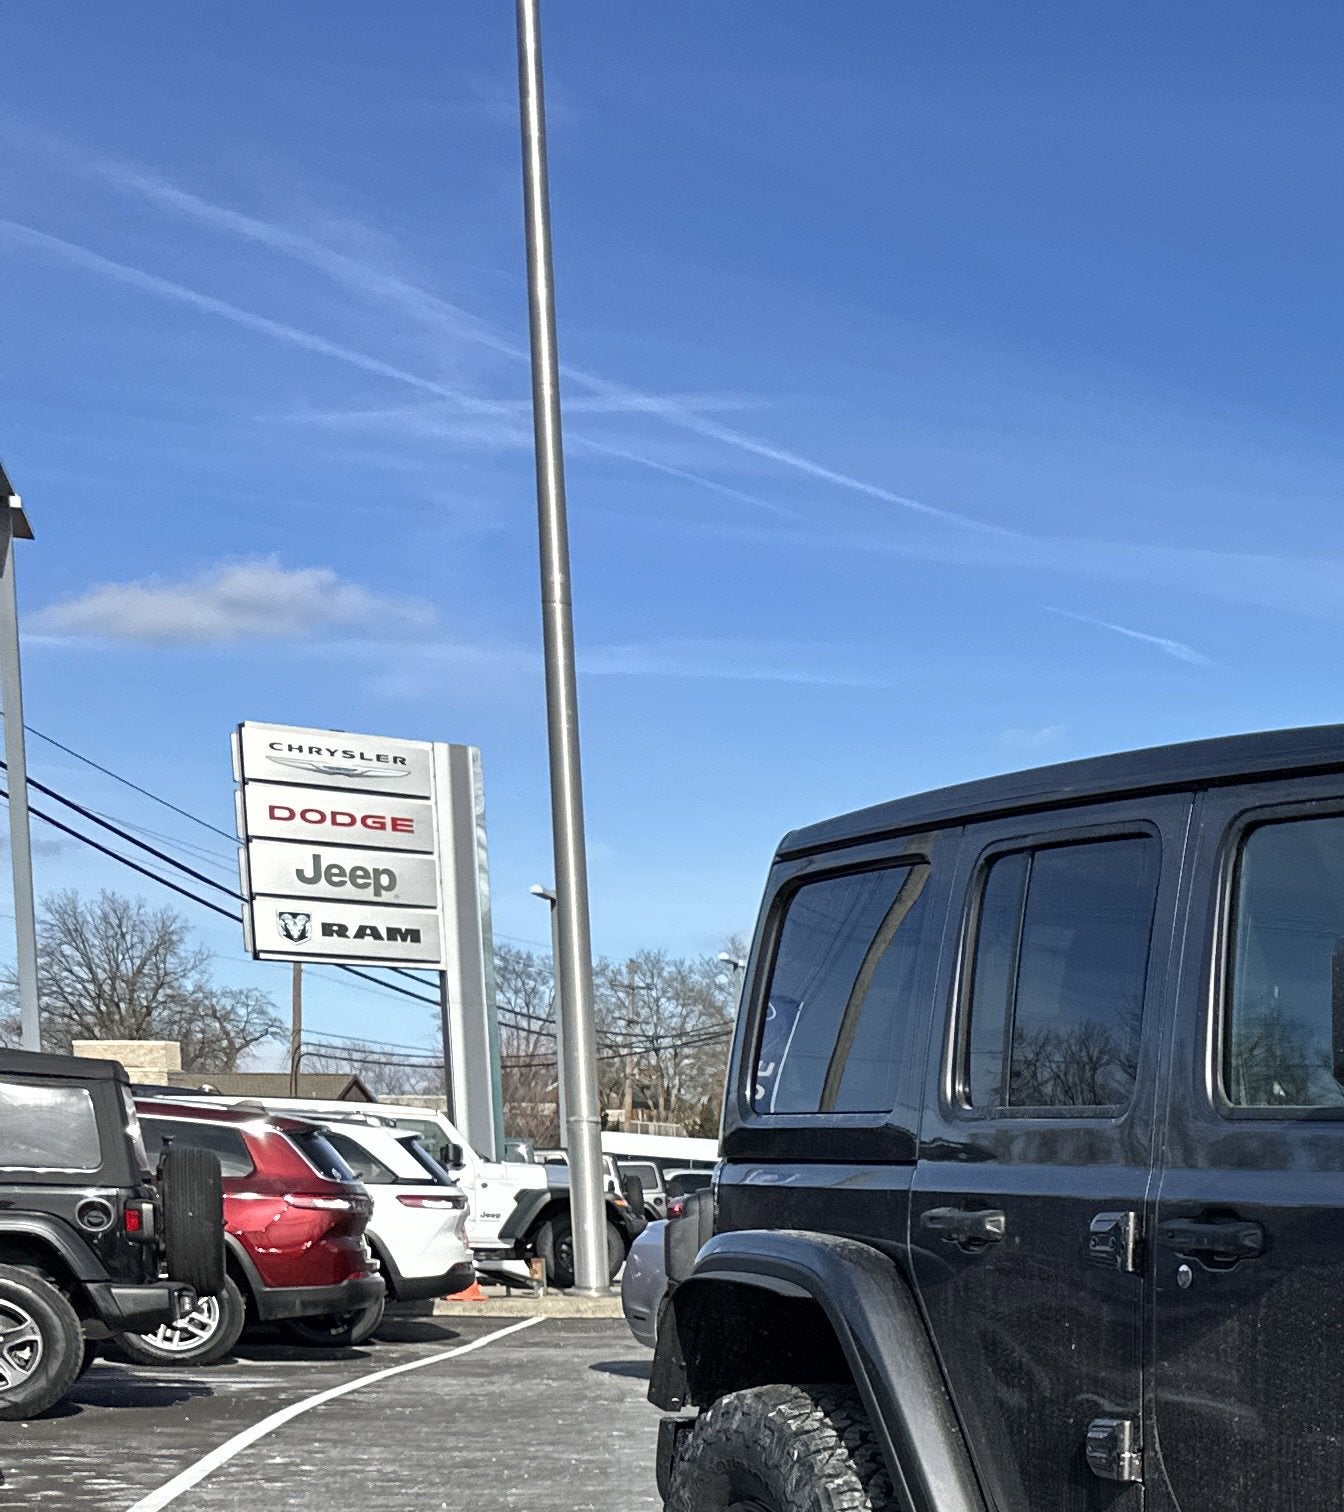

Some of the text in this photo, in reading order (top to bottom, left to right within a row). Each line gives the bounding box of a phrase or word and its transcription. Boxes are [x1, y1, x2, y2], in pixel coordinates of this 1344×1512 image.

[268, 742, 407, 765] CHRYSLER
[268, 805, 414, 833] DODGE
[295, 854, 397, 897] Jeep
[321, 922, 421, 943] RAM
